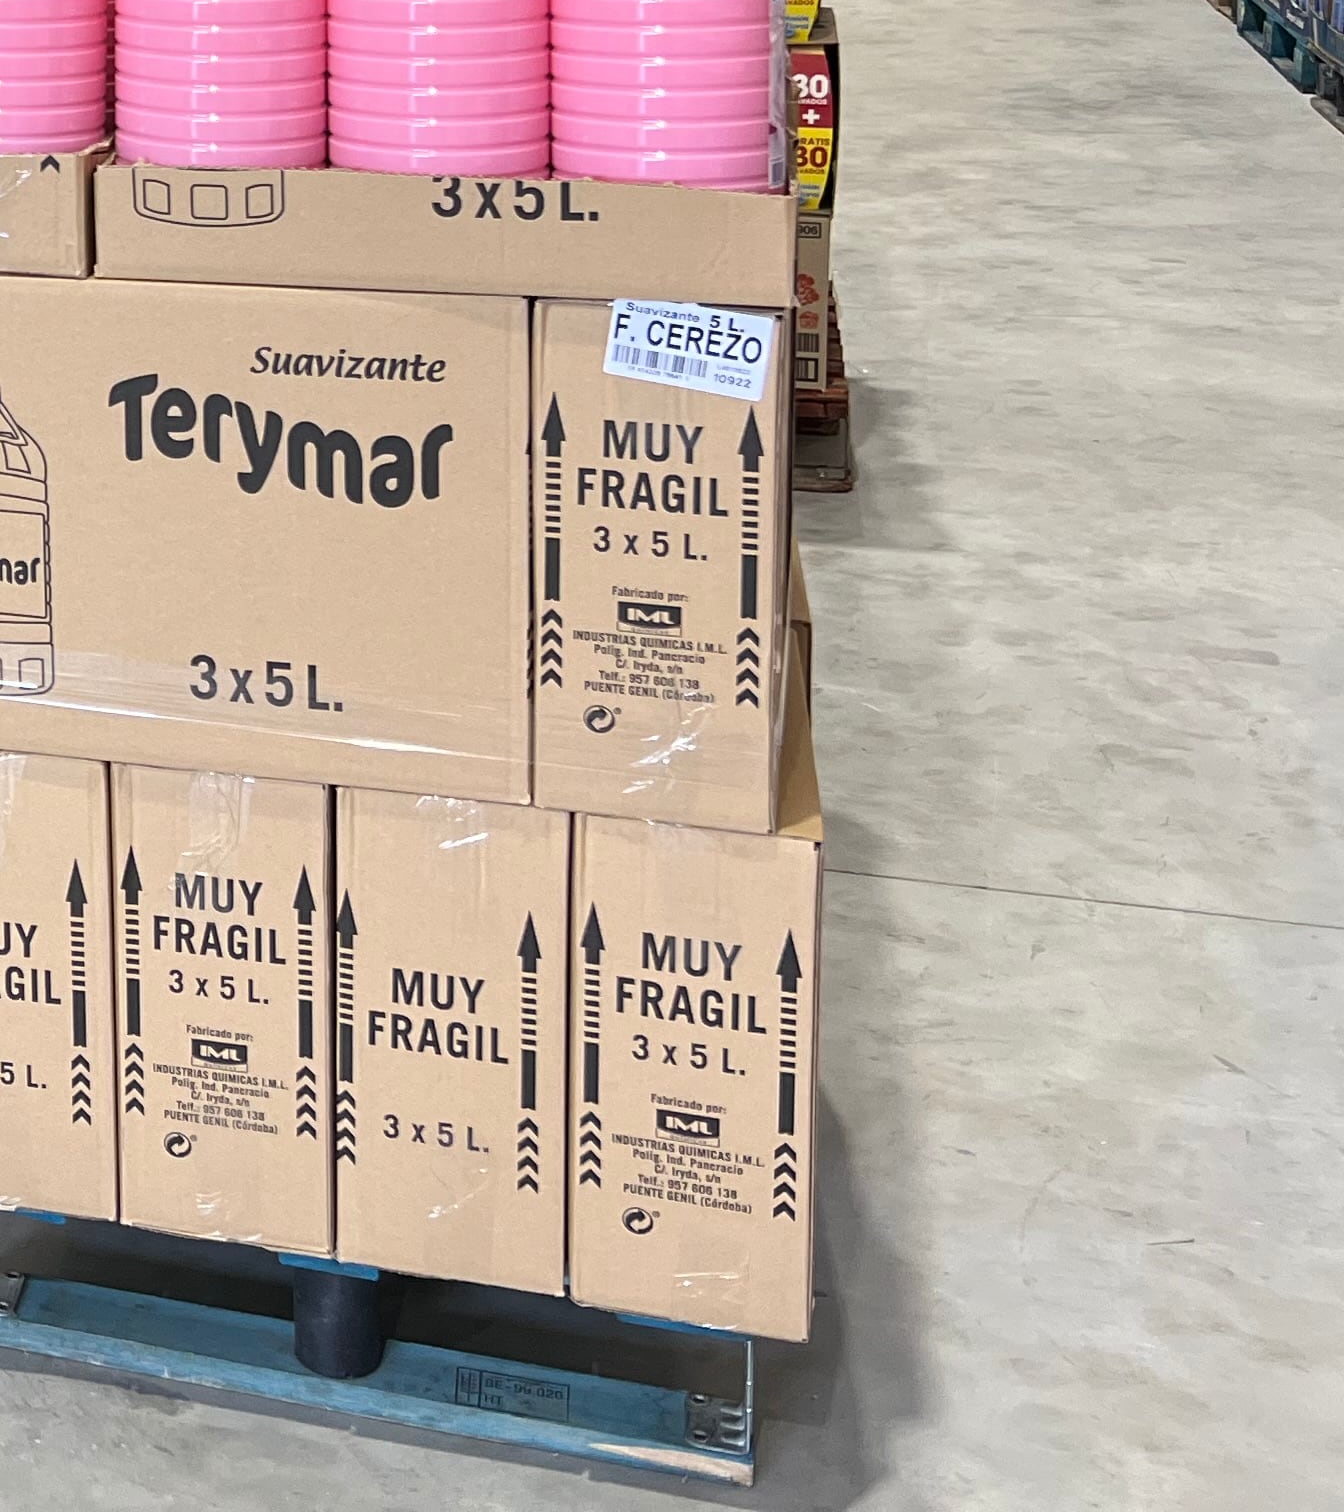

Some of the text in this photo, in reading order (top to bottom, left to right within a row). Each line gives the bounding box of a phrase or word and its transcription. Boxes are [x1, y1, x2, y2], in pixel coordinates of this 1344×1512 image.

[614, 313, 762, 364] F. CEREZO
[626, 302, 744, 333] Suavizante 5 L.
[249, 344, 447, 384] Suavizante
[713, 373, 751, 389] 10922
[107, 372, 454, 510] Terymar
[603, 419, 704, 465] MUY
[577, 467, 729, 518] FRAGIL
[189, 661, 344, 713] 3 x 5 L.
[173, 870, 263, 918] MUY
[152, 914, 288, 968] FRAGIL
[641, 930, 743, 984] MUY
[615, 974, 768, 1037] FRAGIL
[650, 1093, 727, 1114] Fabricado por:
[665, 1115, 712, 1135] IML
[612, 1133, 675, 1153] INDUSTRIAS
[679, 1144, 731, 1162] QUIMICAS
[623, 1183, 752, 1214] PUENTE GENIL (Córdoba)
[668, 1179, 688, 1190] 957
[718, 1188, 737, 1199] 138
